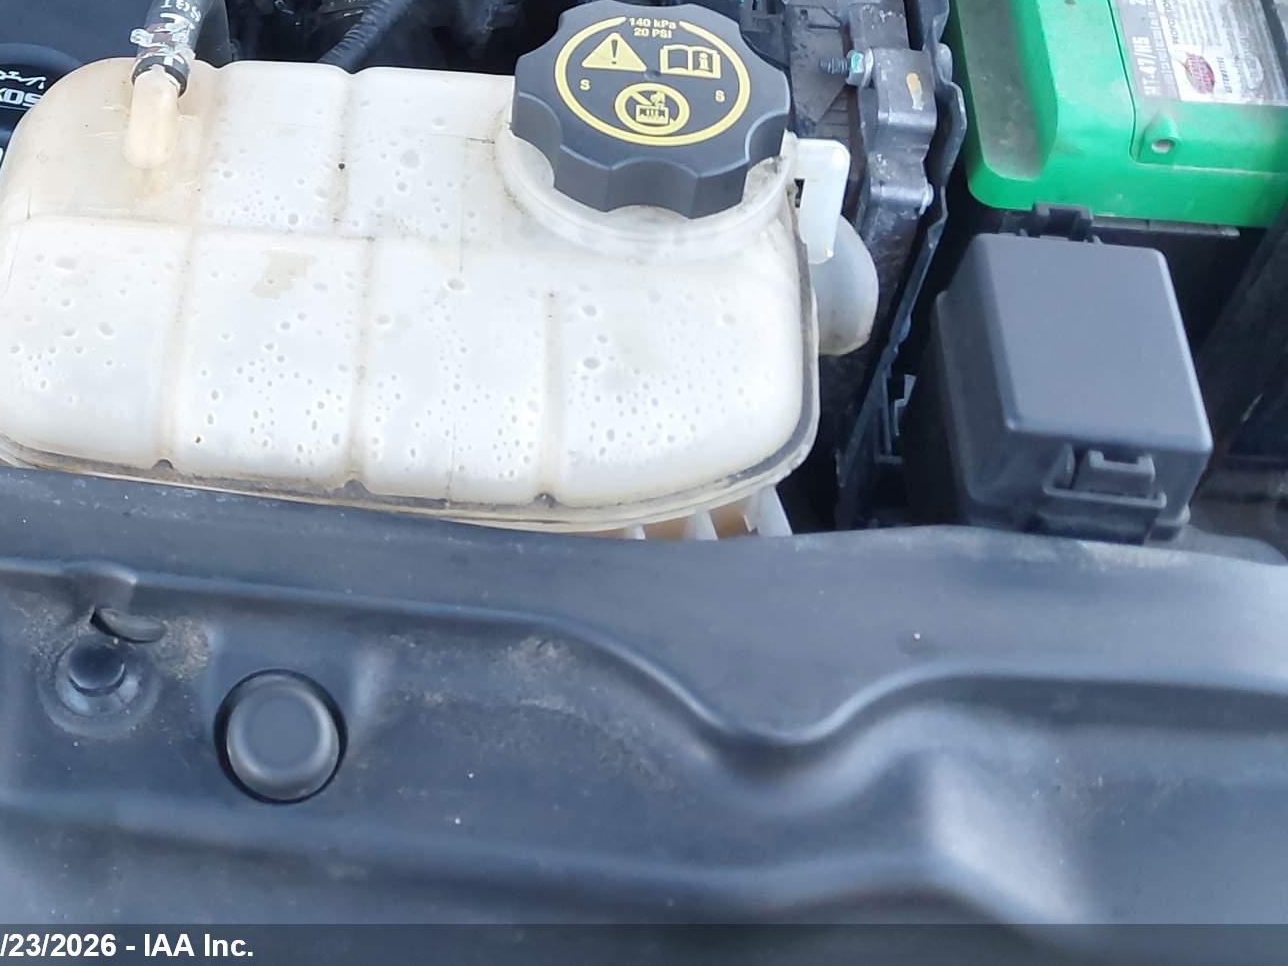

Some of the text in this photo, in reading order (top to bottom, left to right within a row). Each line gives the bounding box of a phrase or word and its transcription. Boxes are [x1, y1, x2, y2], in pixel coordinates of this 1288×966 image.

[629, 17, 650, 28] 140
[634, 28, 672, 39] 20 PSI
